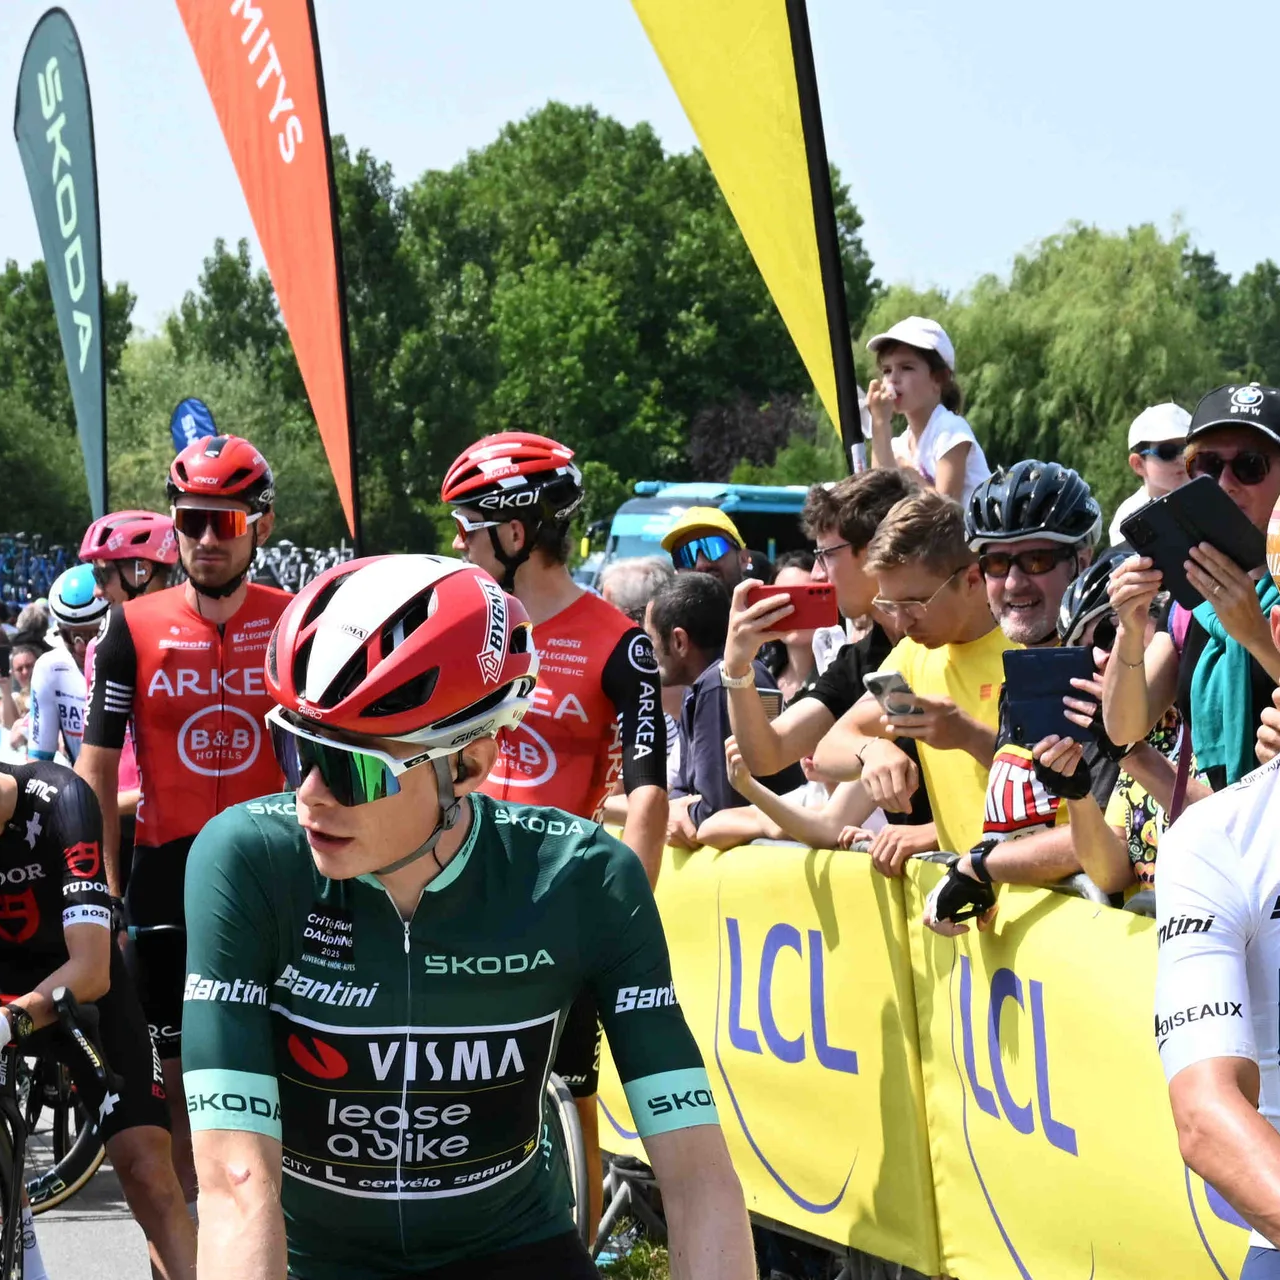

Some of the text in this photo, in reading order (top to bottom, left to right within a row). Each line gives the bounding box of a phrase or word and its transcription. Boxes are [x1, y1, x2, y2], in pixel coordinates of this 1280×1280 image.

[484, 581, 507, 652] BYGMA
[546, 651, 587, 665] LEGENDRE
[147, 668, 271, 697] ARKE
[298, 705, 322, 720] GIRO
[633, 681, 655, 760] ARKEA
[451, 719, 495, 747] GIRO
[196, 750, 242, 761] HOTELS
[320, 947, 340, 958] 2025
[275, 964, 379, 1008] Santini
[725, 916, 859, 1075] LCL
[1161, 1001, 1243, 1036] OISEAUX
[368, 1037, 525, 1082] VISMA
[959, 953, 1079, 1157] LCL
[327, 1098, 471, 1130] lease
[453, 1158, 513, 1185] SRAM
